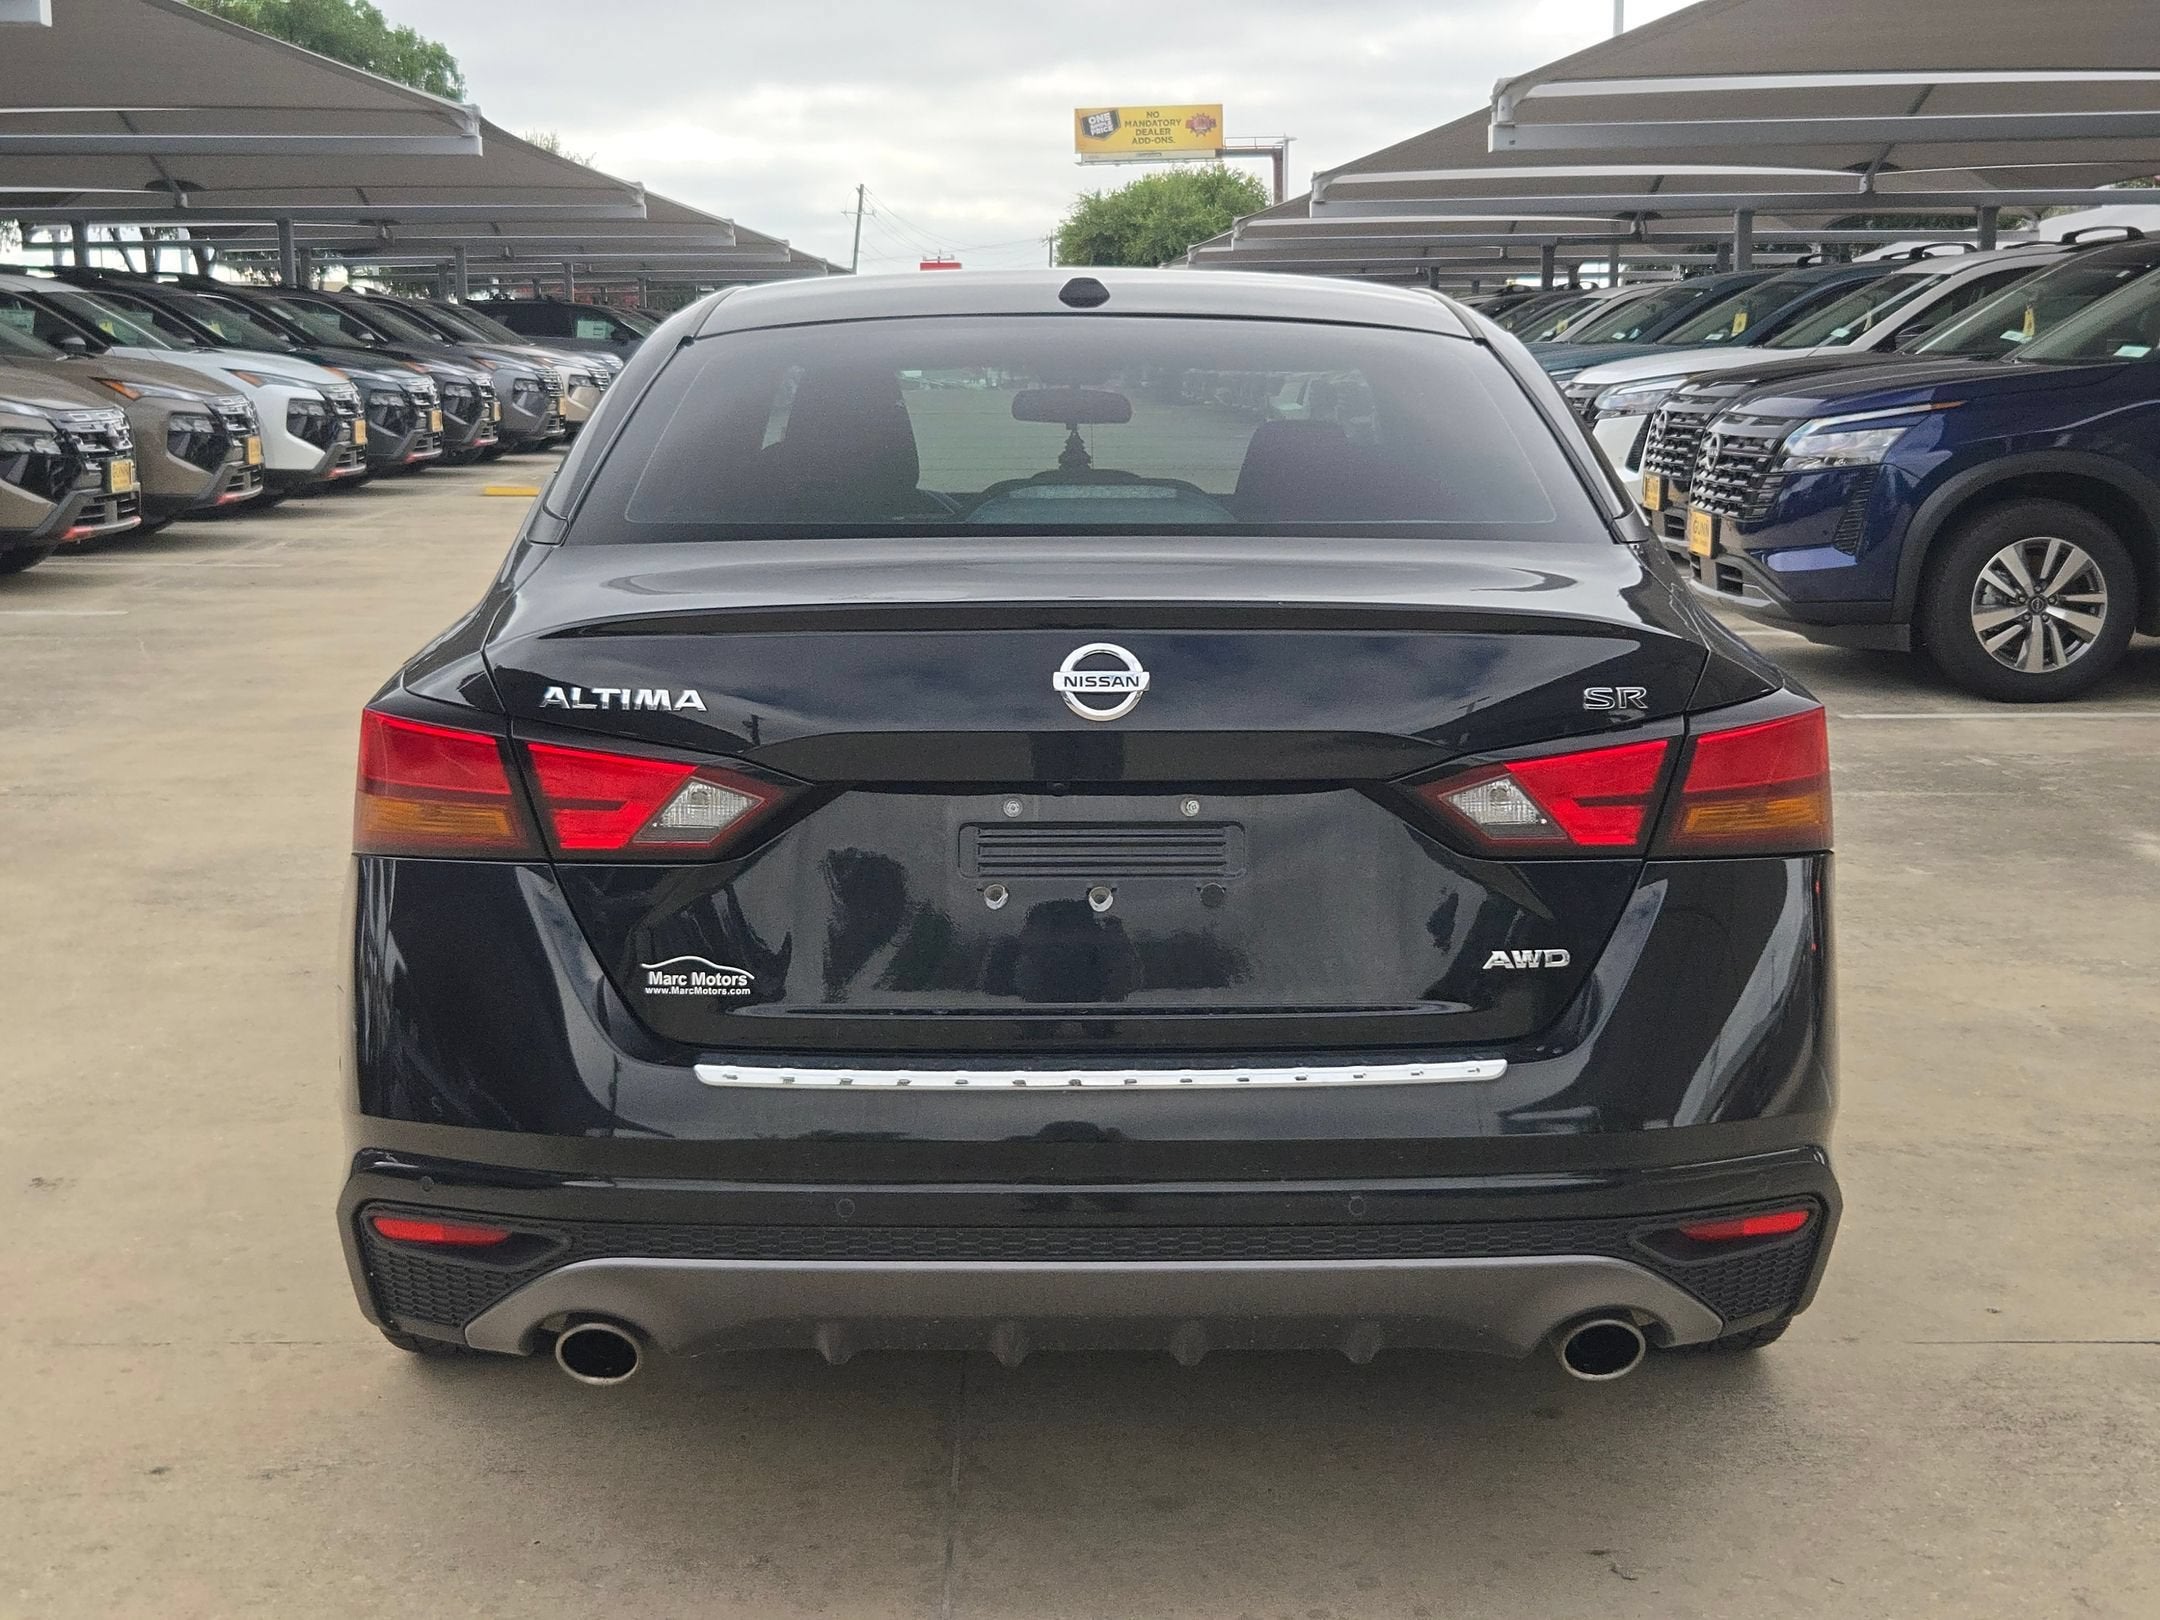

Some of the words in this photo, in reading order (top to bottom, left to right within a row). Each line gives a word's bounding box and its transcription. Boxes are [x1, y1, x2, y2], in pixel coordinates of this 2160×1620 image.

[1088, 112, 1111, 124] ONE
[1124, 119, 1182, 128] MANDATORY
[1091, 127, 1114, 136] PRICE
[1135, 128, 1171, 136] DEALER
[1131, 137, 1176, 145] ADD-ONS.
[1064, 676, 1139, 687] NISSAN
[539, 686, 707, 711] ALTIMA
[1583, 687, 1648, 709] SR
[1482, 949, 1571, 969] AWD
[648, 971, 687, 986] Marc
[691, 972, 748, 986] Motors
[645, 986, 751, 995] www.MarcMotors.com
